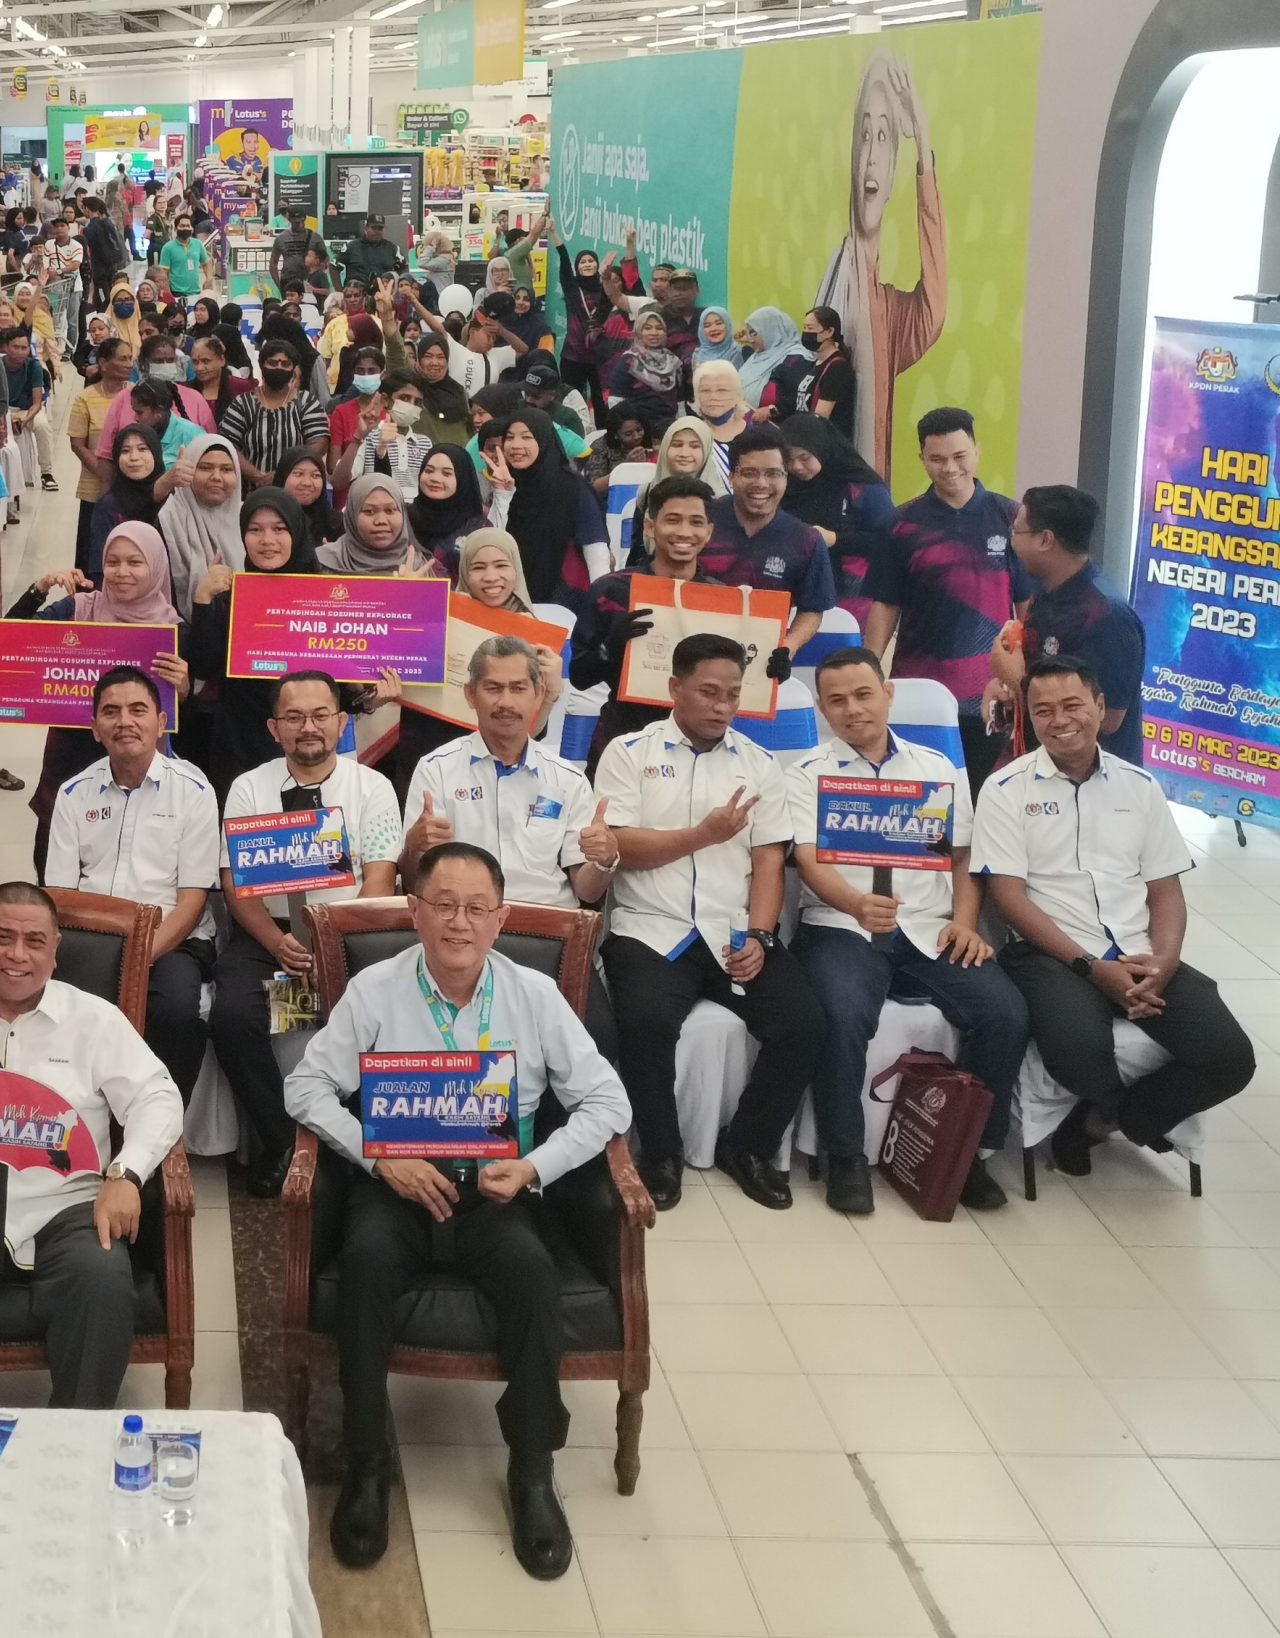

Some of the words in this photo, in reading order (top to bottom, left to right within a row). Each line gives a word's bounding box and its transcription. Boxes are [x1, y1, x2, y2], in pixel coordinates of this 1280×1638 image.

[581, 131, 604, 187] Janji
[604, 144, 624, 188] apa
[580, 197, 602, 250] Janji
[635, 207, 658, 268] beg
[659, 214, 708, 272] plastik.
[1189, 382, 1212, 393] KPDN
[1213, 383, 1240, 395] PERAK
[1201, 446, 1270, 487] HARI
[1151, 523, 1280, 569] KEBANGSA
[1147, 557, 1227, 596] NEGERI
[1232, 574, 1280, 607] PER
[266, 608, 325, 616] PERTANDINGAN
[1190, 602, 1258, 639] 2023
[289, 620, 327, 633] NAIB
[332, 622, 388, 635] JOHAN
[308, 636, 368, 652] RM250
[1, 655, 59, 664] PERTANDINGAN
[42, 667, 100, 682] JOHAN
[1179, 691, 1238, 717] Rahmah
[1177, 730, 1195, 748] 19
[1197, 735, 1233, 759] MAC
[1237, 745, 1280, 771] 2023
[1151, 744, 1212, 772] Lotus's
[1212, 763, 1266, 787] BERCHAM
[880, 782, 891, 792] di
[229, 818, 278, 831] Dapatkan
[279, 815, 289, 825] di
[825, 812, 941, 834] RAHMAH
[237, 836, 276, 850] BAKUL
[237, 840, 338, 869] RAHMAH
[365, 1057, 428, 1070] Dapatkan
[431, 1057, 443, 1067] di
[446, 1056, 472, 1068] sini!
[373, 1081, 431, 1094] JUALAN
[371, 1096, 505, 1119] RAHMAH
[882, 1119, 899, 1164] 8
